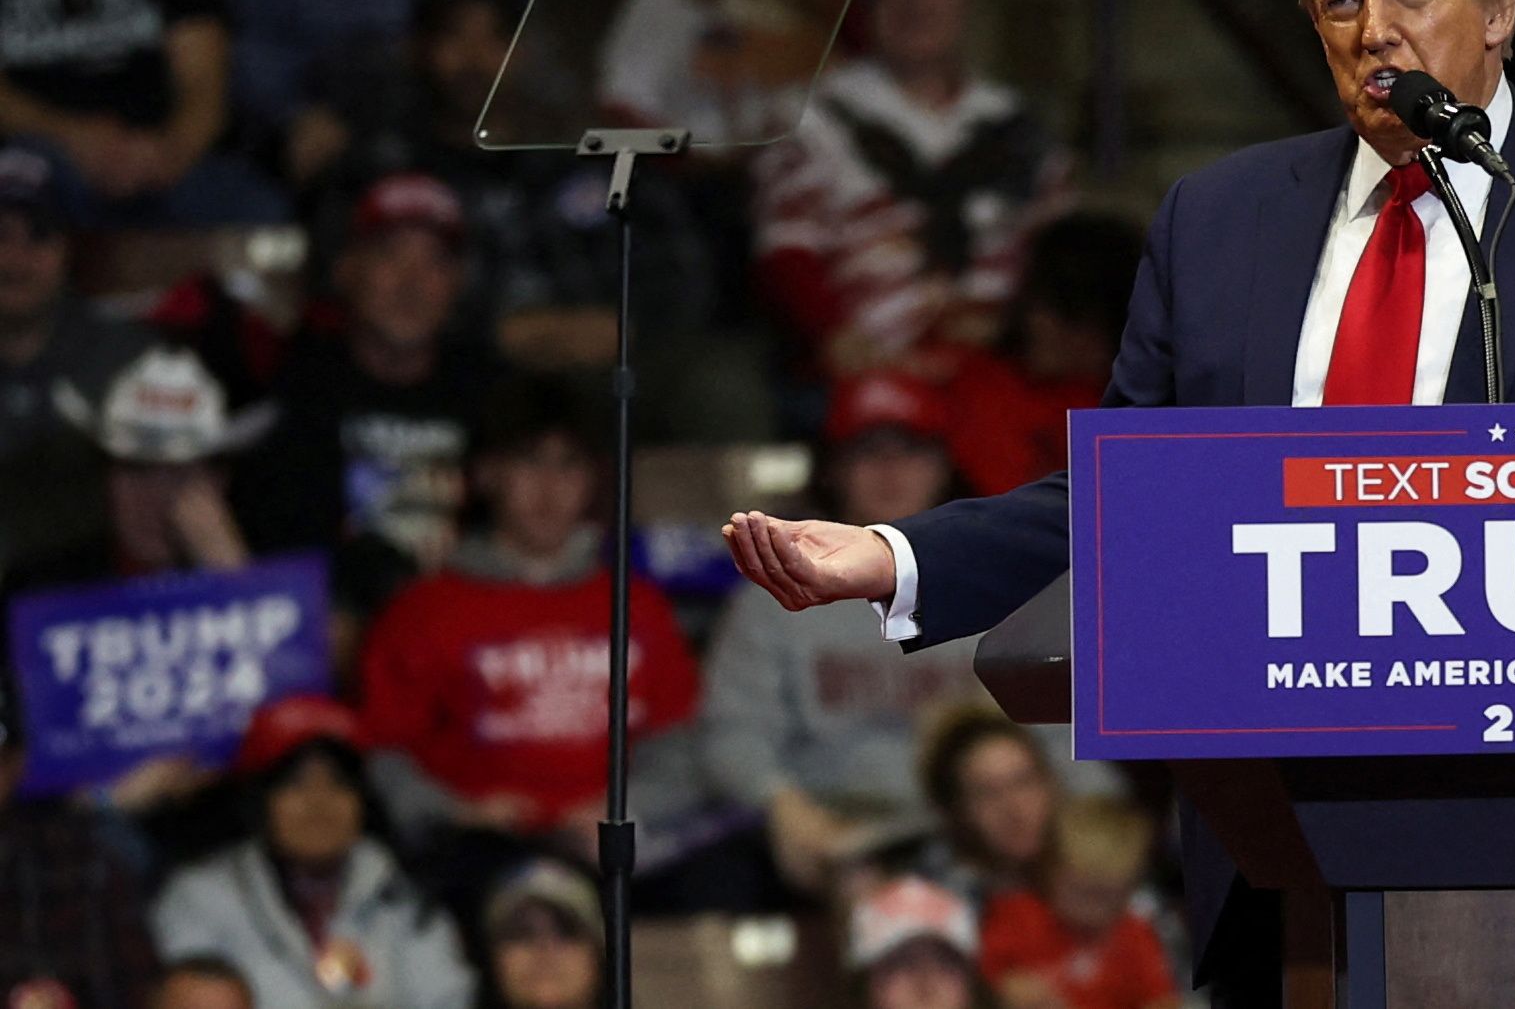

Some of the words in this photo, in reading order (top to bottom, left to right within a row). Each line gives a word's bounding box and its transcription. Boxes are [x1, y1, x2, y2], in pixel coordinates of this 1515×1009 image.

[1323, 462, 1450, 501] TEXT
[40, 596, 300, 682] TRUMP
[84, 654, 266, 728] 2024
[1266, 662, 1372, 689] MAKE
